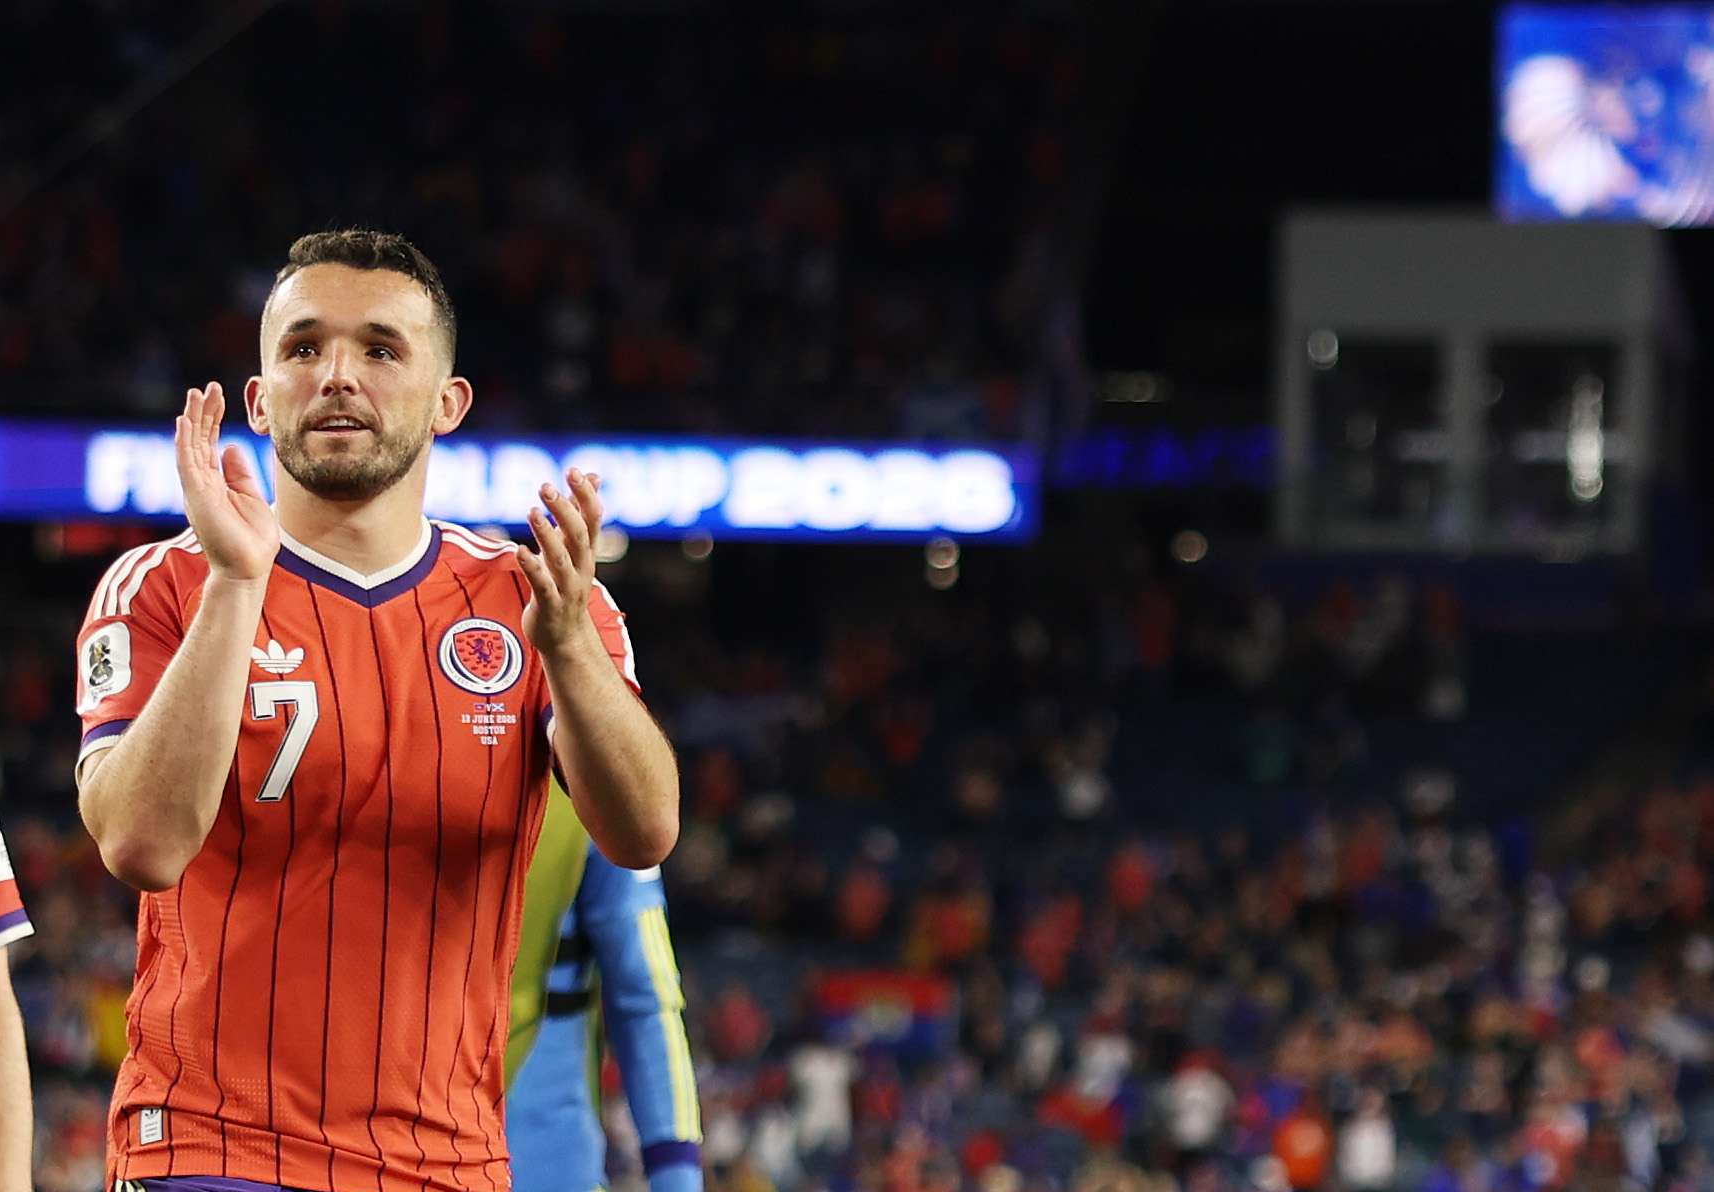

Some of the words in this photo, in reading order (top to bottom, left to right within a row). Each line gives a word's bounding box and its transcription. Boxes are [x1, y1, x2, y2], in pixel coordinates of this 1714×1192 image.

[726, 446, 1016, 533] 2026
[472, 714, 495, 724] JUNE
[473, 725, 506, 735] BOSTON
[250, 681, 319, 802] 7
[480, 736, 499, 745] USA
